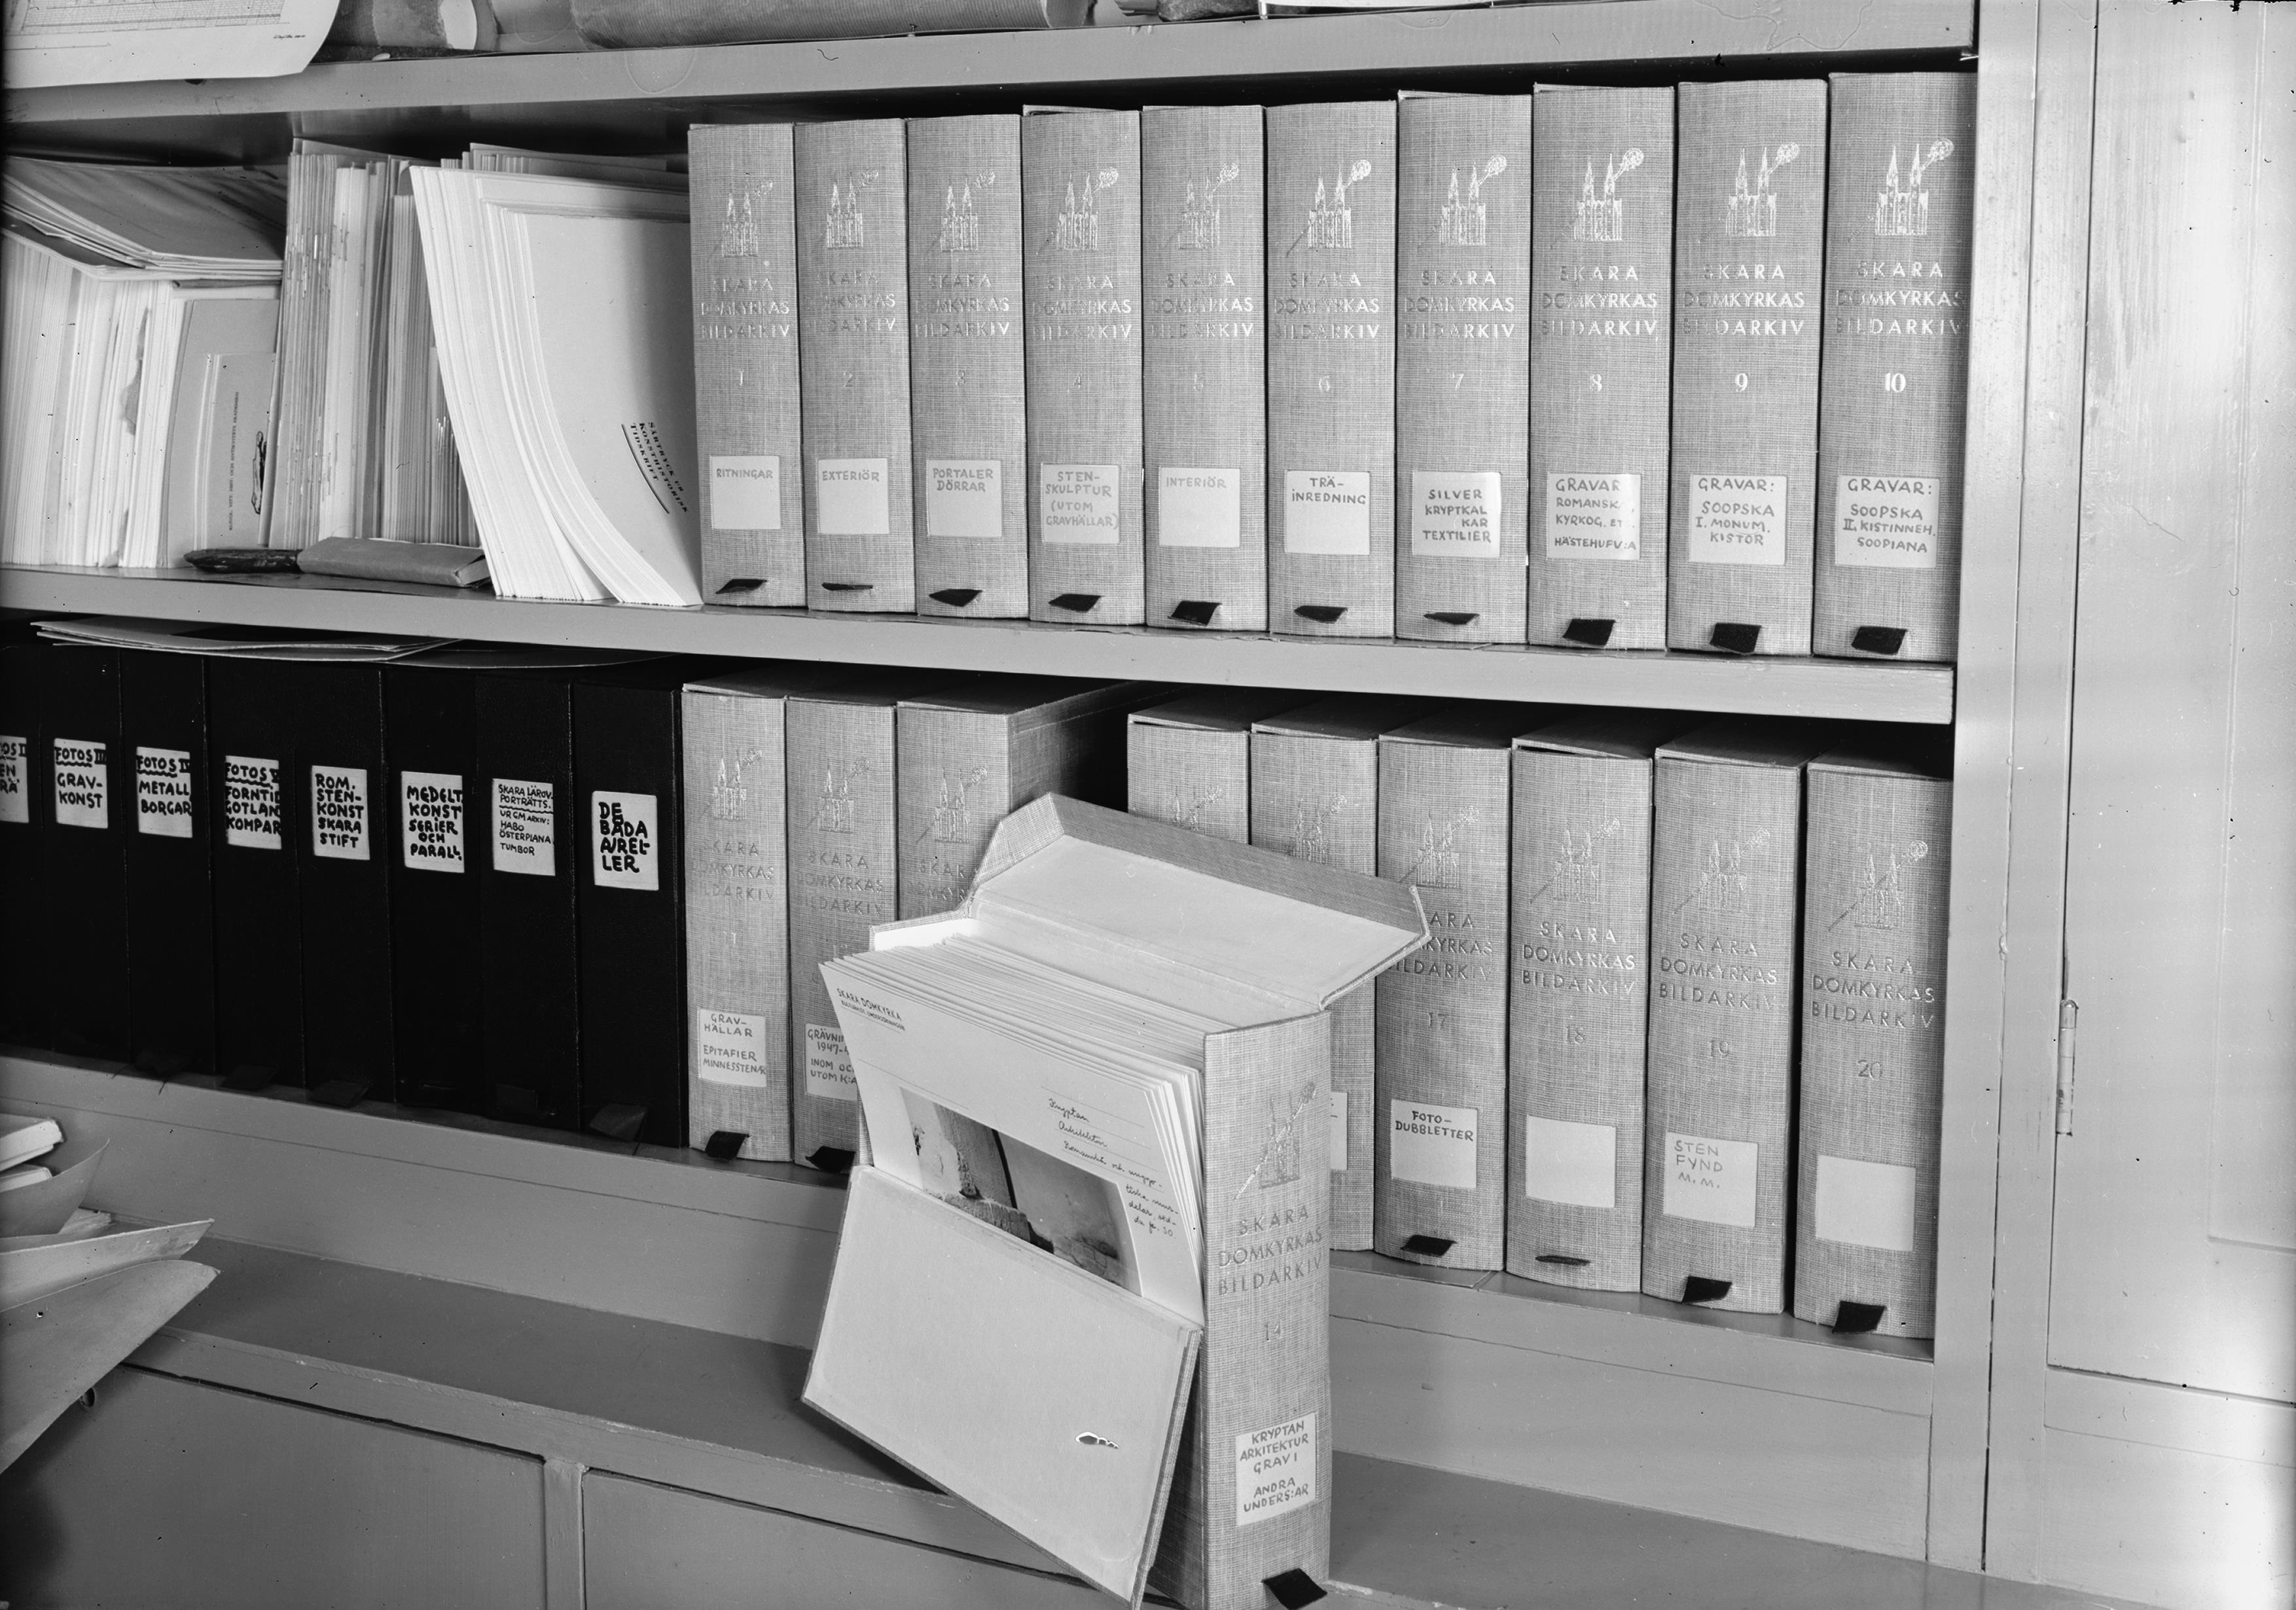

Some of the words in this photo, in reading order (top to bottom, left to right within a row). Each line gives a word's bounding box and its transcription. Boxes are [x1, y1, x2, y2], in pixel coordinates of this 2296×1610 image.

[1420, 270, 1496, 286] SKARA
[1559, 266, 1638, 281] SKARA
[1703, 264, 1785, 280] SKARA
[1857, 262, 1943, 278] SKARA
[1835, 290, 1964, 307] DOMKYRKAS
[1452, 372, 1464, 391] 7
[1589, 373, 1603, 392] 8
[1734, 372, 1749, 393] 9
[1884, 372, 1907, 393] 10
[716, 468, 773, 480] RITNINGAR
[822, 469, 880, 482] EXTERIÖR
[933, 468, 994, 480] PORTALER
[1057, 471, 1101, 482] STEN-
[1309, 475, 1344, 488] TRÄ-
[937, 480, 986, 492] DÖRRAR
[1045, 484, 1112, 498] SKULPTUR
[1166, 476, 1227, 490] INTERIÖR
[1698, 477, 1774, 492] GRAVAR:
[1848, 478, 1933, 495] GRAVAR:
[1428, 489, 1482, 500] SILVER
[1051, 501, 1094, 512] (UTOM
[1425, 505, 1488, 516] KRYPTKAL
[1702, 501, 1775, 517] SOOPSKA
[1850, 503, 1924, 520] SOOPSKA
[1462, 517, 1488, 528] KAR
[1710, 518, 1770, 533] MONUM.
[1860, 520, 1936, 537] KISTINNEH.
[1422, 529, 1492, 543] TEXTILIER
[1710, 532, 1764, 546] KISTOR
[1857, 537, 1928, 553] SOOPIANA
[54, 746, 93, 762] FOTOS
[136, 755, 177, 772] FOTOS
[225, 762, 267, 782] FOTOS
[57, 772, 103, 789] GRAV-
[139, 780, 190, 796] METALL
[315, 773, 355, 791] ROM.
[317, 788, 361, 804] STEN-
[498, 783, 525, 796] SKARA
[59, 790, 103, 809] KONST
[141, 798, 192, 817] BORGAR
[500, 795, 551, 810] PORTRÄTTS.
[317, 802, 364, 819] KONST
[409, 802, 462, 819] KONST
[499, 810, 511, 819] UR
[527, 815, 550, 825] ARKIV:
[598, 802, 622, 819] DE
[318, 817, 361, 834] SKARA
[408, 817, 458, 836] SERIER
[501, 820, 524, 832] HABO
[599, 814, 649, 840] BÅDA
[319, 832, 359, 848] STIFT
[418, 832, 445, 844] OCH
[410, 843, 462, 861] PARALL.
[500, 842, 535, 855] TUMBOR
[602, 854, 640, 873] LER
[918, 859, 965, 879] SKAR
[1429, 912, 1474, 929] ARA
[1538, 921, 1617, 944] SKARA
[1420, 935, 1494, 957] KYRKAS
[1680, 932, 1758, 957] SKARA
[1522, 943, 1636, 971] DOMKYRKAS
[1832, 950, 1916, 975] SKARA
[1660, 956, 1778, 984] DOMKYRKAS
[1522, 969, 1635, 995] BILDARKIV
[1812, 974, 1936, 1004] DOMKYRKAS
[1659, 982, 1777, 1011] BILDARKIV
[710, 1013, 747, 1025] GRAV-
[1811, 1001, 1935, 1029] BILDARKIV
[704, 1023, 753, 1037] HÄLLAR
[703, 1045, 757, 1062] EPITAFIER
[811, 1058, 834, 1071] INOM
[838, 1064, 855, 1073] OC
[1856, 1059, 1884, 1081] 20
[810, 1069, 837, 1082] UTOM
[1412, 1109, 1452, 1124] FOTO-
[1395, 1119, 1474, 1143] DUBBLETTER
[1674, 1139, 1719, 1156] STEN
[1676, 1154, 1723, 1172] FYND
[1238, 1205, 1310, 1236] SKARA
[1218, 1226, 1323, 1268] DOMKYRKAS
[1217, 1254, 1322, 1297] BILDARKIV
[1251, 1420, 1304, 1444] KRYPTAN
[1240, 1433, 1309, 1461] ARKITEKTUR
[1253, 1453, 1291, 1475] GRAV
[1253, 1477, 1296, 1498] ANDRA
[1243, 1483, 1309, 1512] UNDERS:AR
